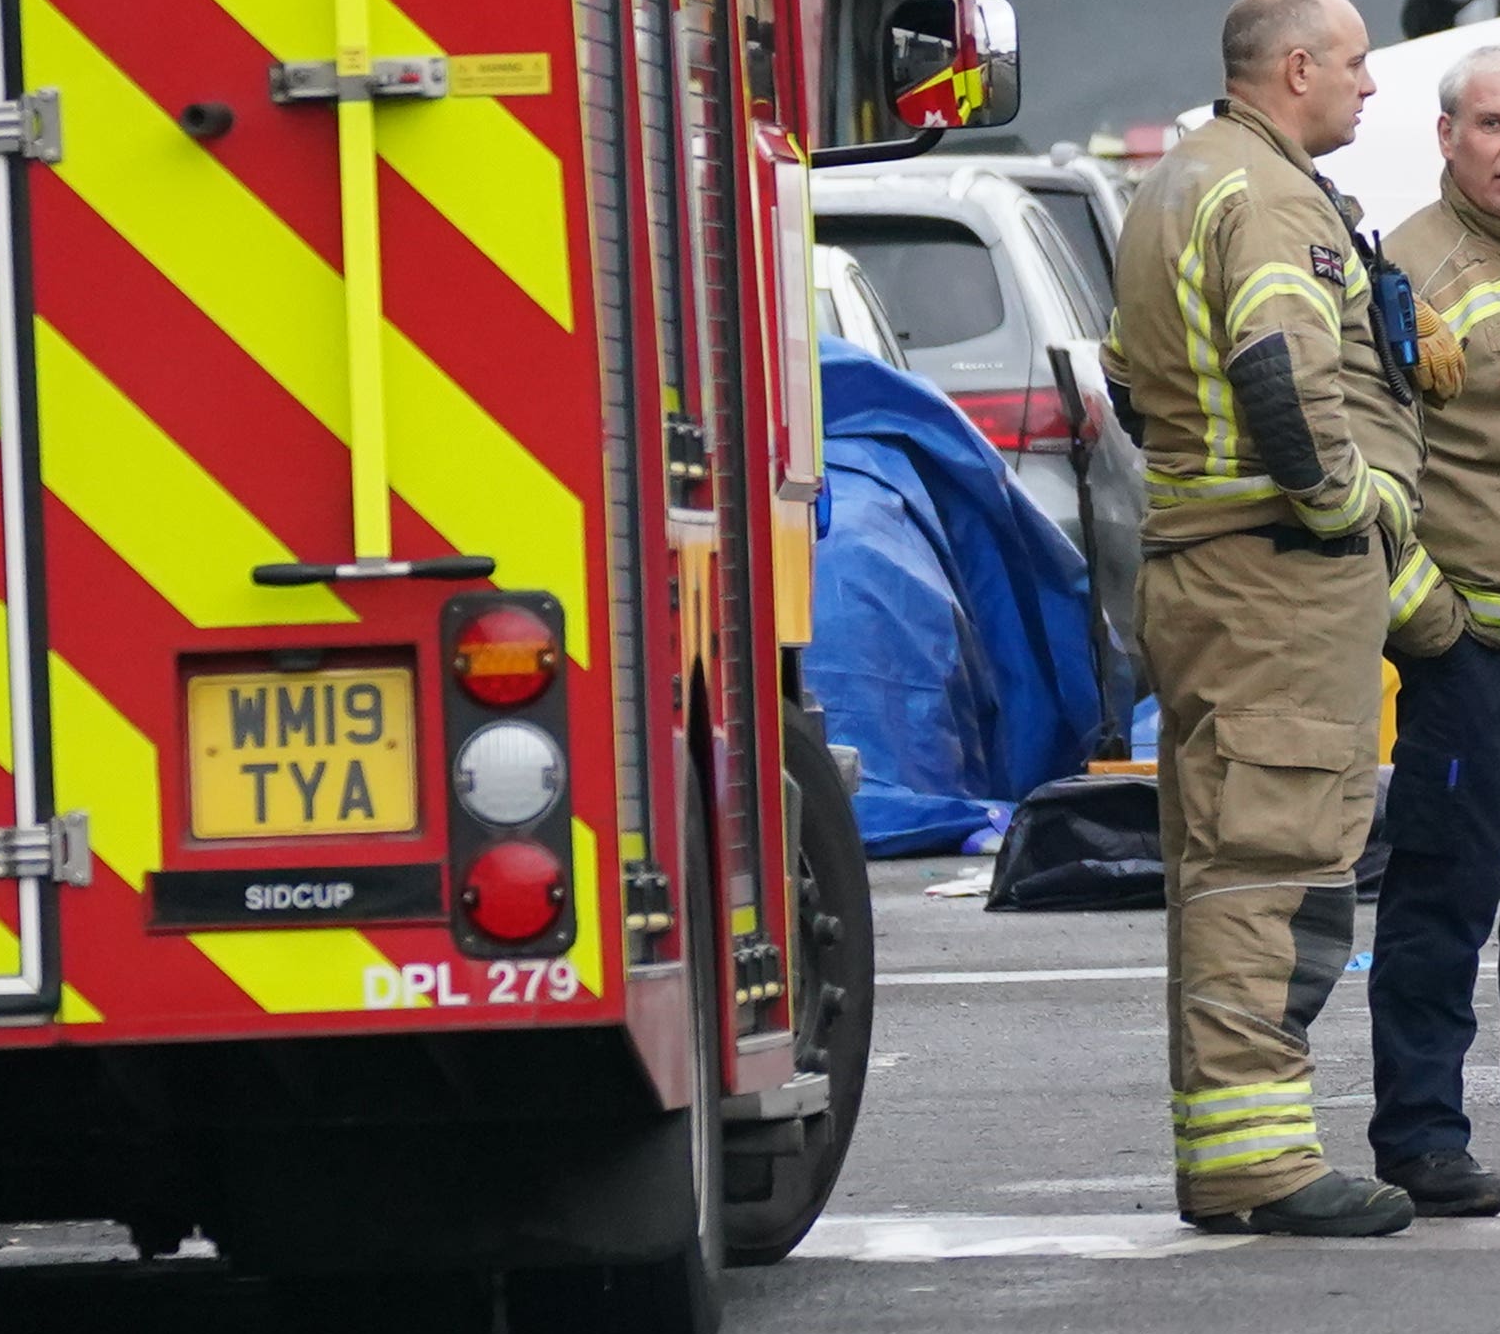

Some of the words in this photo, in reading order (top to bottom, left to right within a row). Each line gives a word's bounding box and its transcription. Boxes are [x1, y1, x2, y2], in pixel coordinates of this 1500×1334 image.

[228, 683, 385, 751] WM19
[239, 759, 377, 825] TYA
[244, 881, 355, 912] SIDCUP
[362, 963, 469, 1010] DPL
[487, 959, 580, 1005] 279
